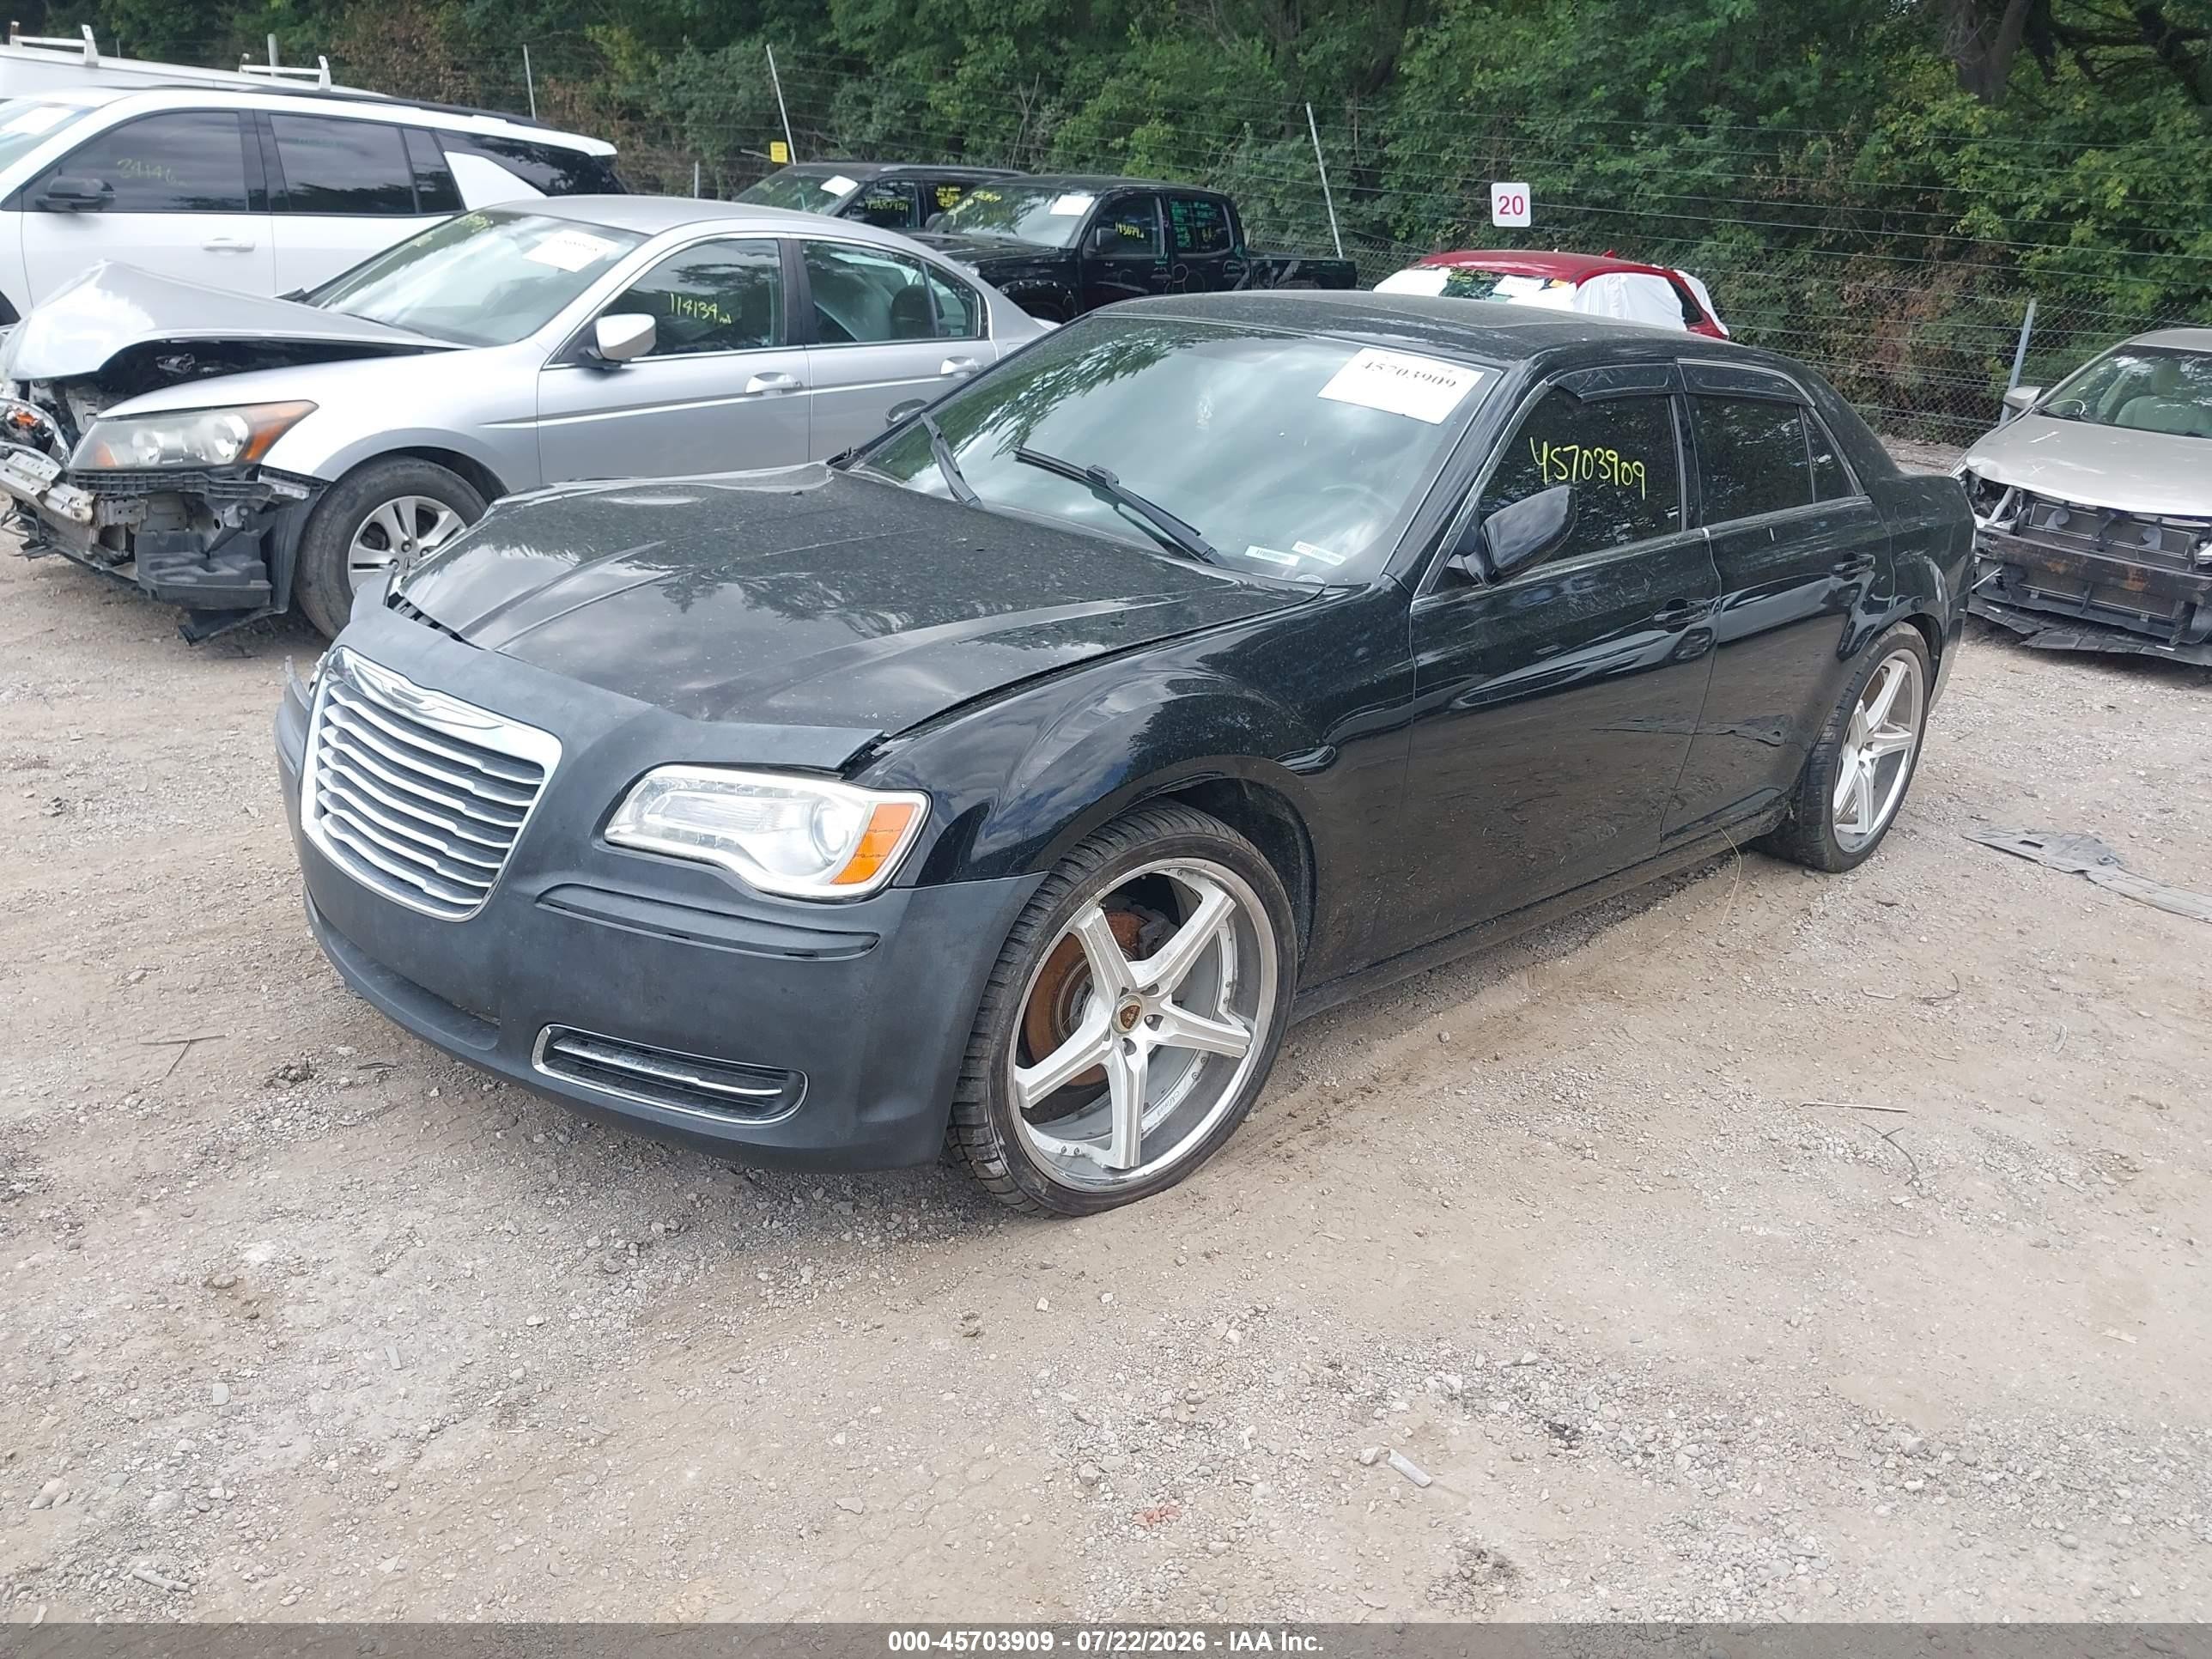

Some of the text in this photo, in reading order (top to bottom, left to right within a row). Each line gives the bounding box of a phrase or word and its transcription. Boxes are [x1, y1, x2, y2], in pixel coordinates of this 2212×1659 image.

[1498, 196, 1524, 216] 20
[1360, 361, 1458, 388] 45703909
[1529, 436, 1646, 501] 45703909
